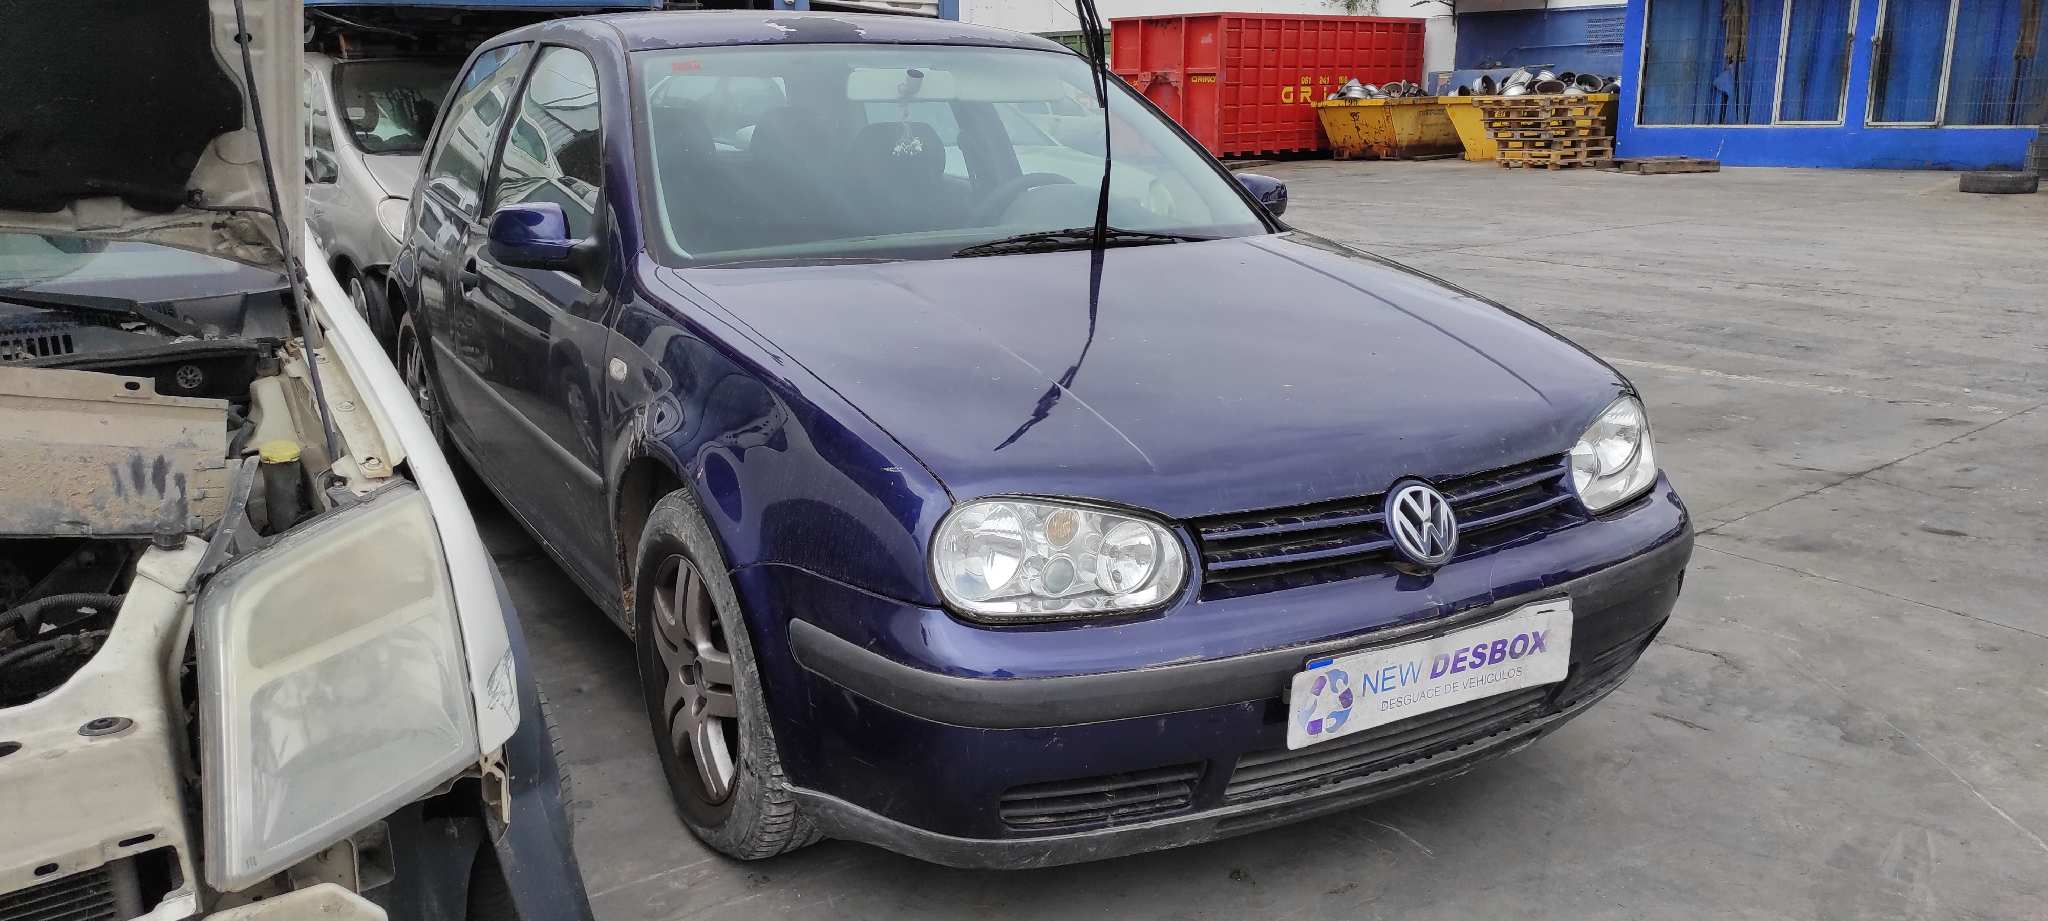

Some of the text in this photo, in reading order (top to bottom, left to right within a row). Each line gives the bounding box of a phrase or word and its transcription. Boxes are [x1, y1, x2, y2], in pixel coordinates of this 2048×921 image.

[1362, 630, 1549, 698] NEW DESBOX
[1380, 666, 1523, 712] DESGUACE DE VEHICULOS
